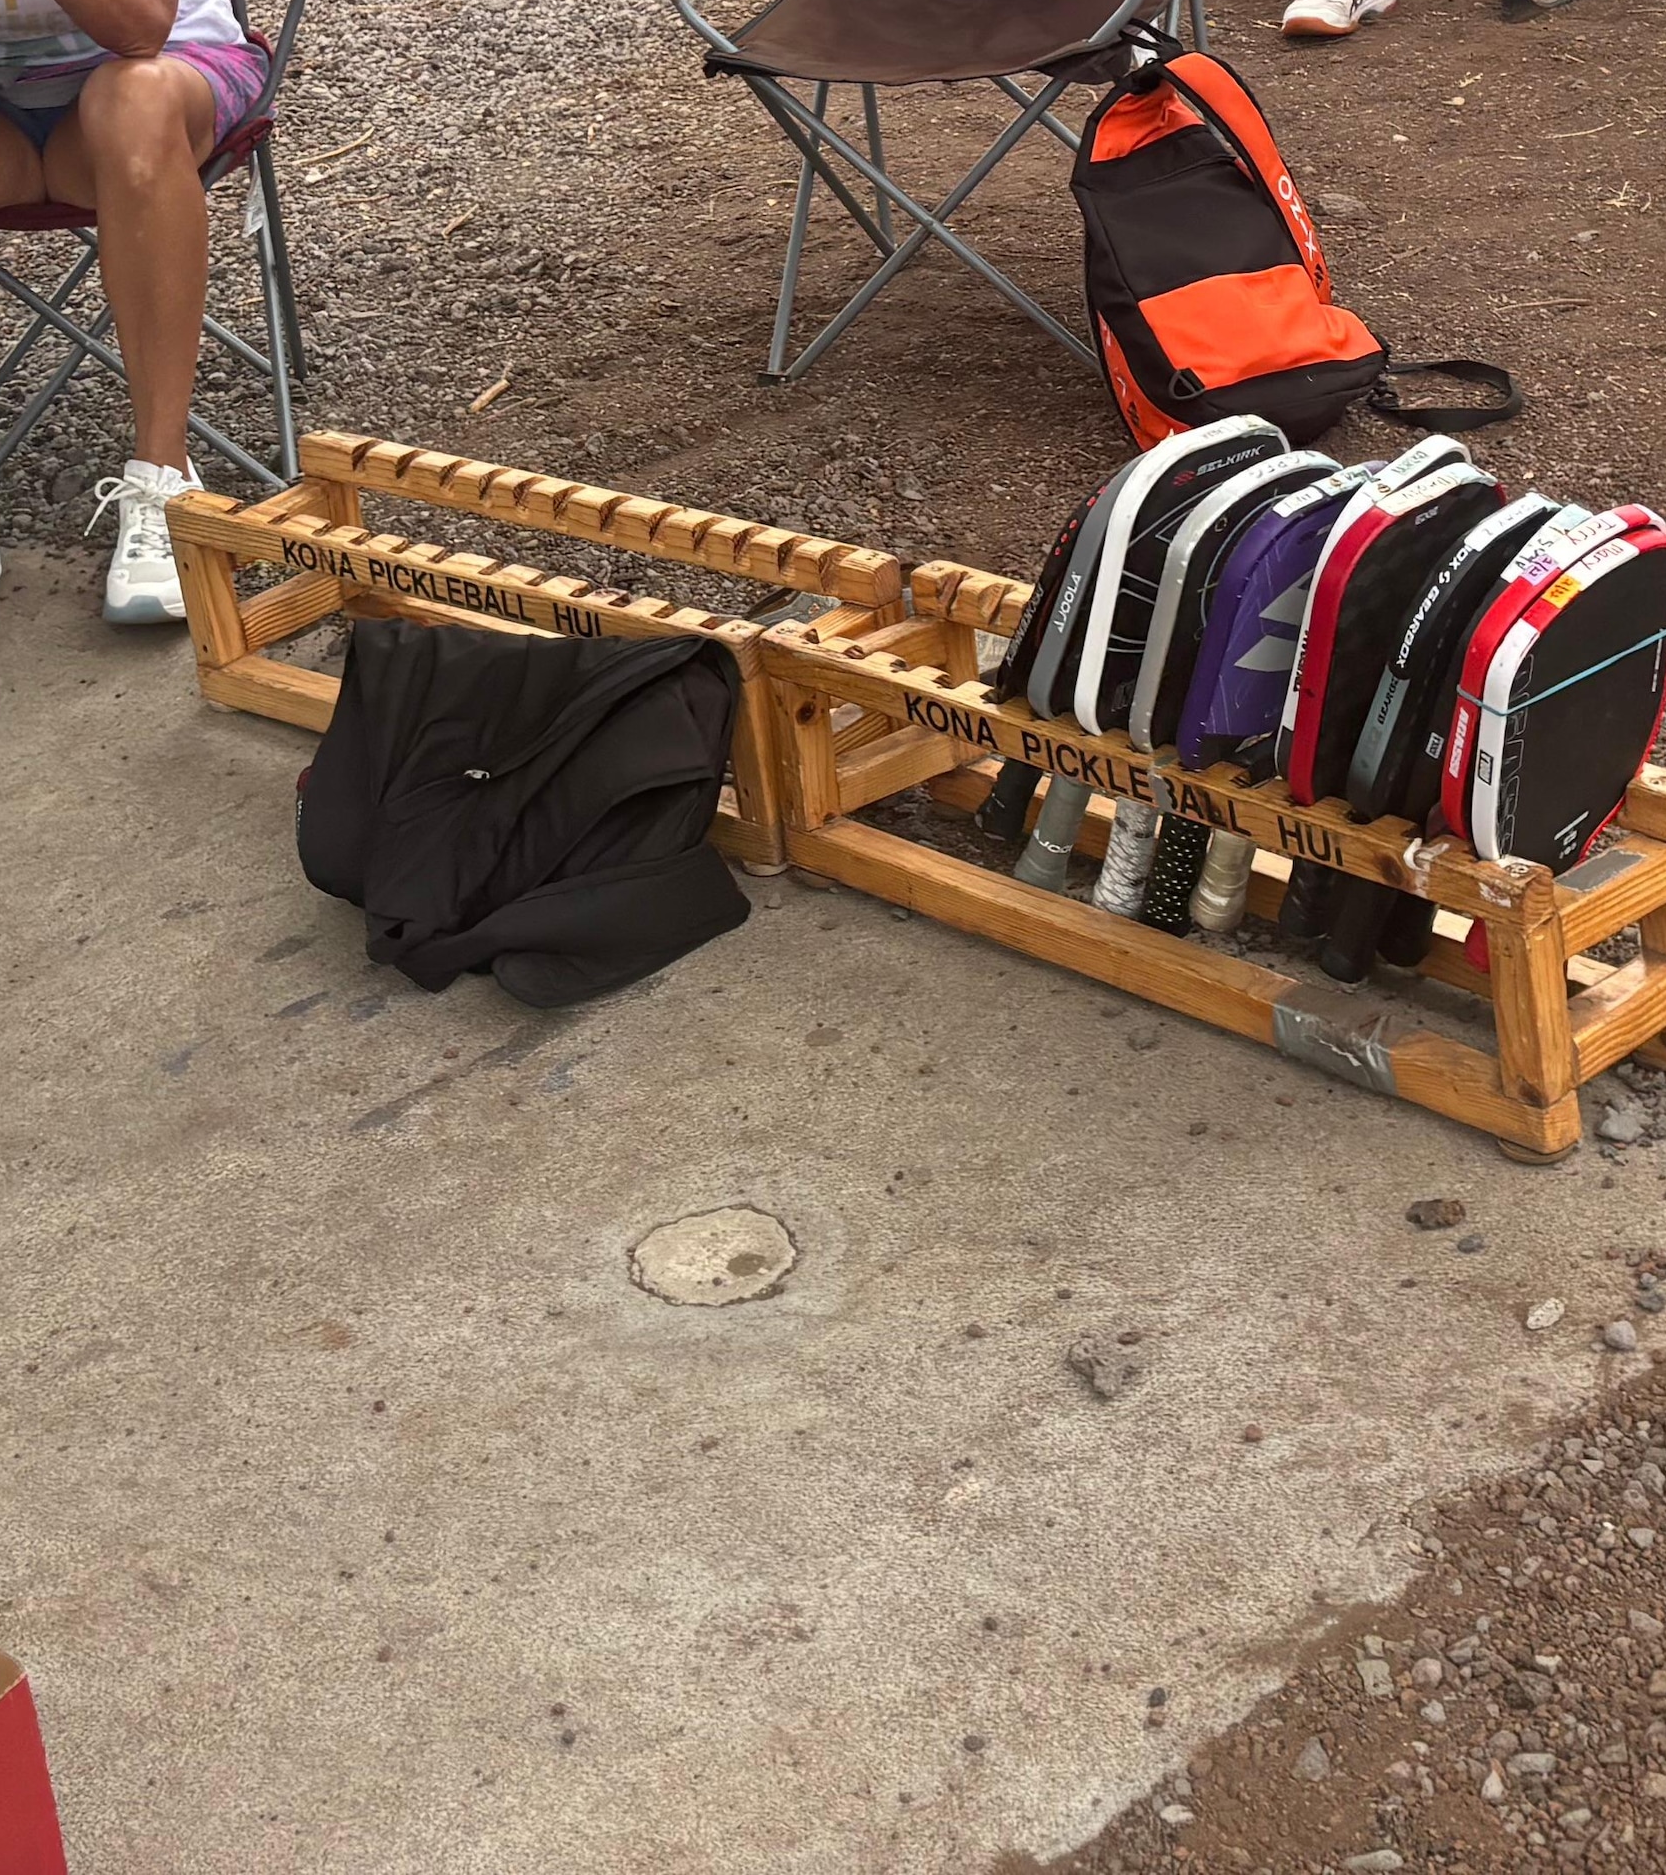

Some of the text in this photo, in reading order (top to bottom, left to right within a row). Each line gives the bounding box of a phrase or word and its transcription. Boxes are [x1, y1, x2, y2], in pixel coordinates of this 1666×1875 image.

[1196, 443, 1266, 476] SELKIRK
[282, 537, 602, 638] KONA PICKLEBALL HUI
[1582, 541, 1626, 571] Mary
[1057, 571, 1082, 626] JOOLA
[1395, 583, 1441, 669] GEARBOX
[903, 691, 1345, 867] KONA PICKLEBALL HUI
